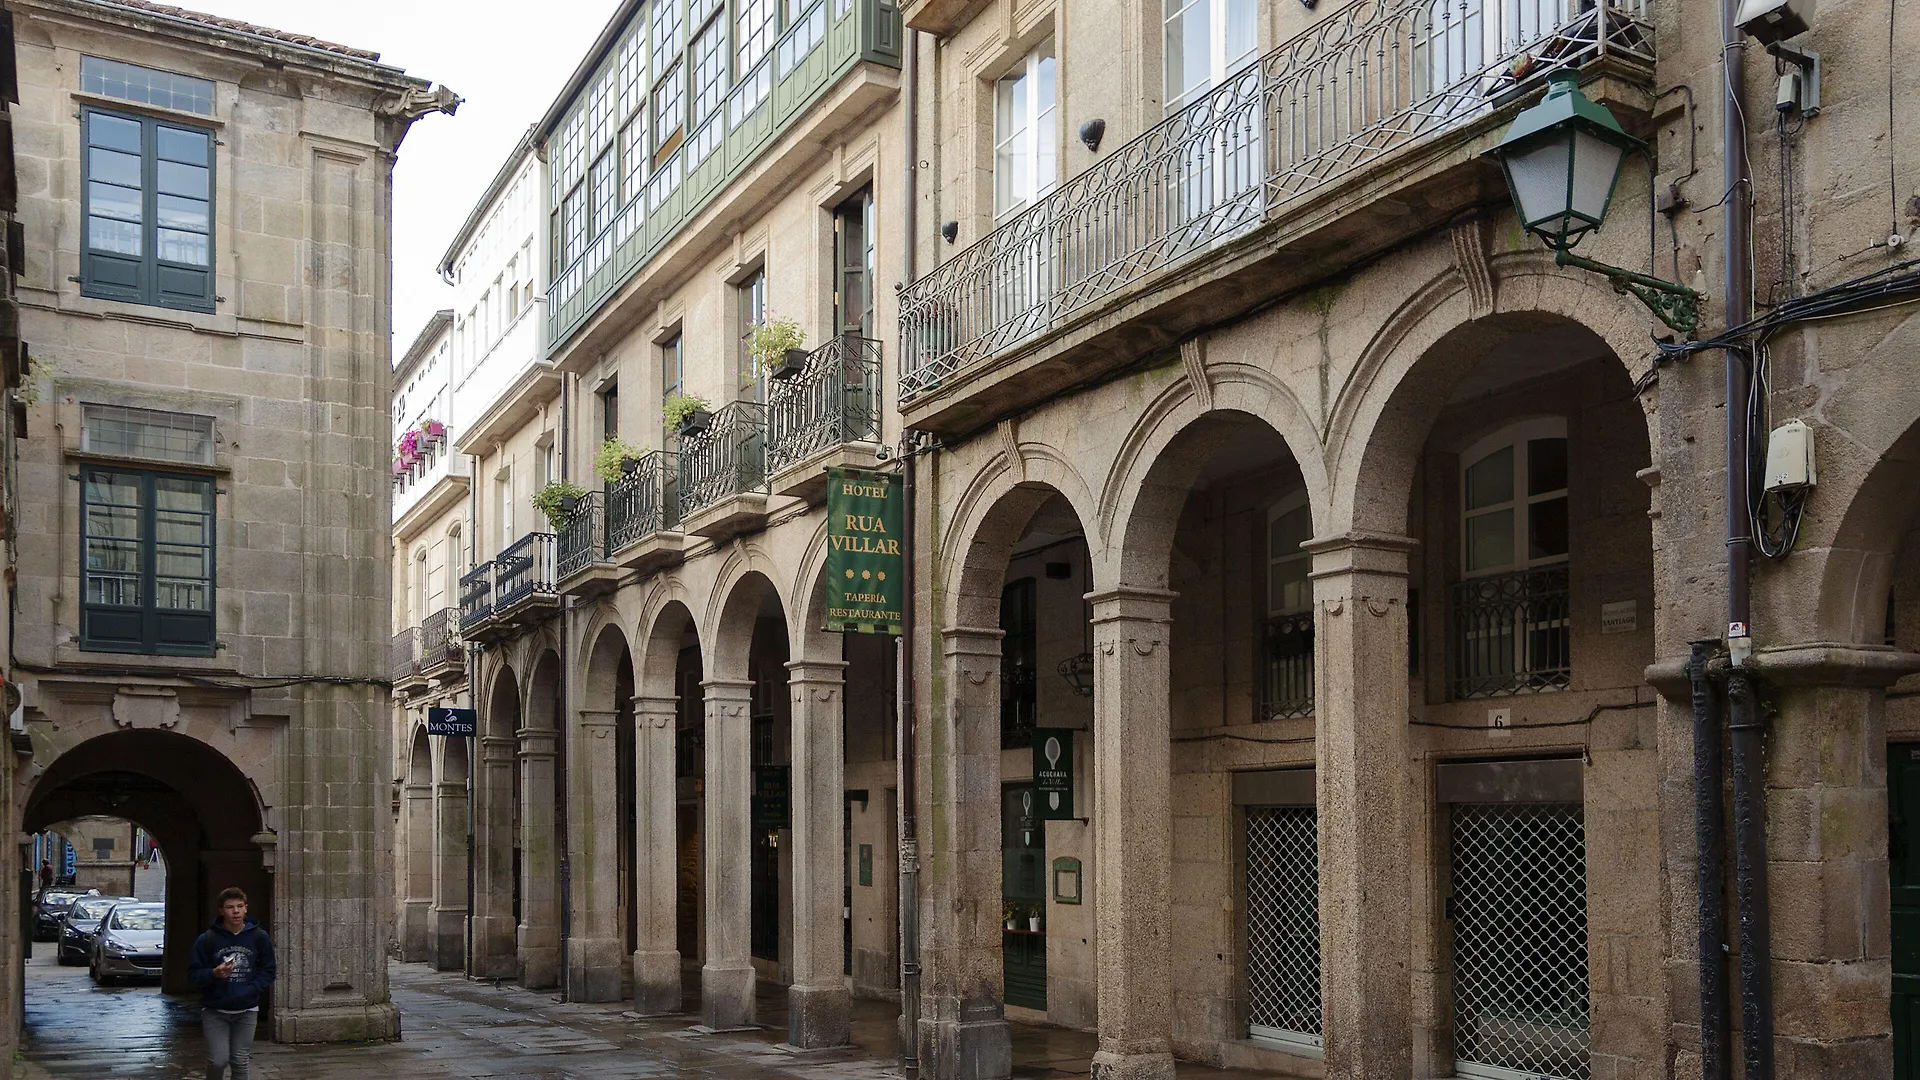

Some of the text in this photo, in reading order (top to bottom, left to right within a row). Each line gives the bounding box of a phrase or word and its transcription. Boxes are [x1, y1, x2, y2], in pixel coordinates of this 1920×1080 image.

[842, 484, 888, 498] HOTEL
[845, 514, 886, 532] RUA
[829, 534, 901, 555] VILLAR
[844, 592, 887, 604] TAPERÍA
[829, 607, 901, 621] RESTAURANTE
[1602, 616, 1636, 626] SANTIAGO
[430, 722, 473, 732] MONTES
[1495, 715, 1502, 730] 6
